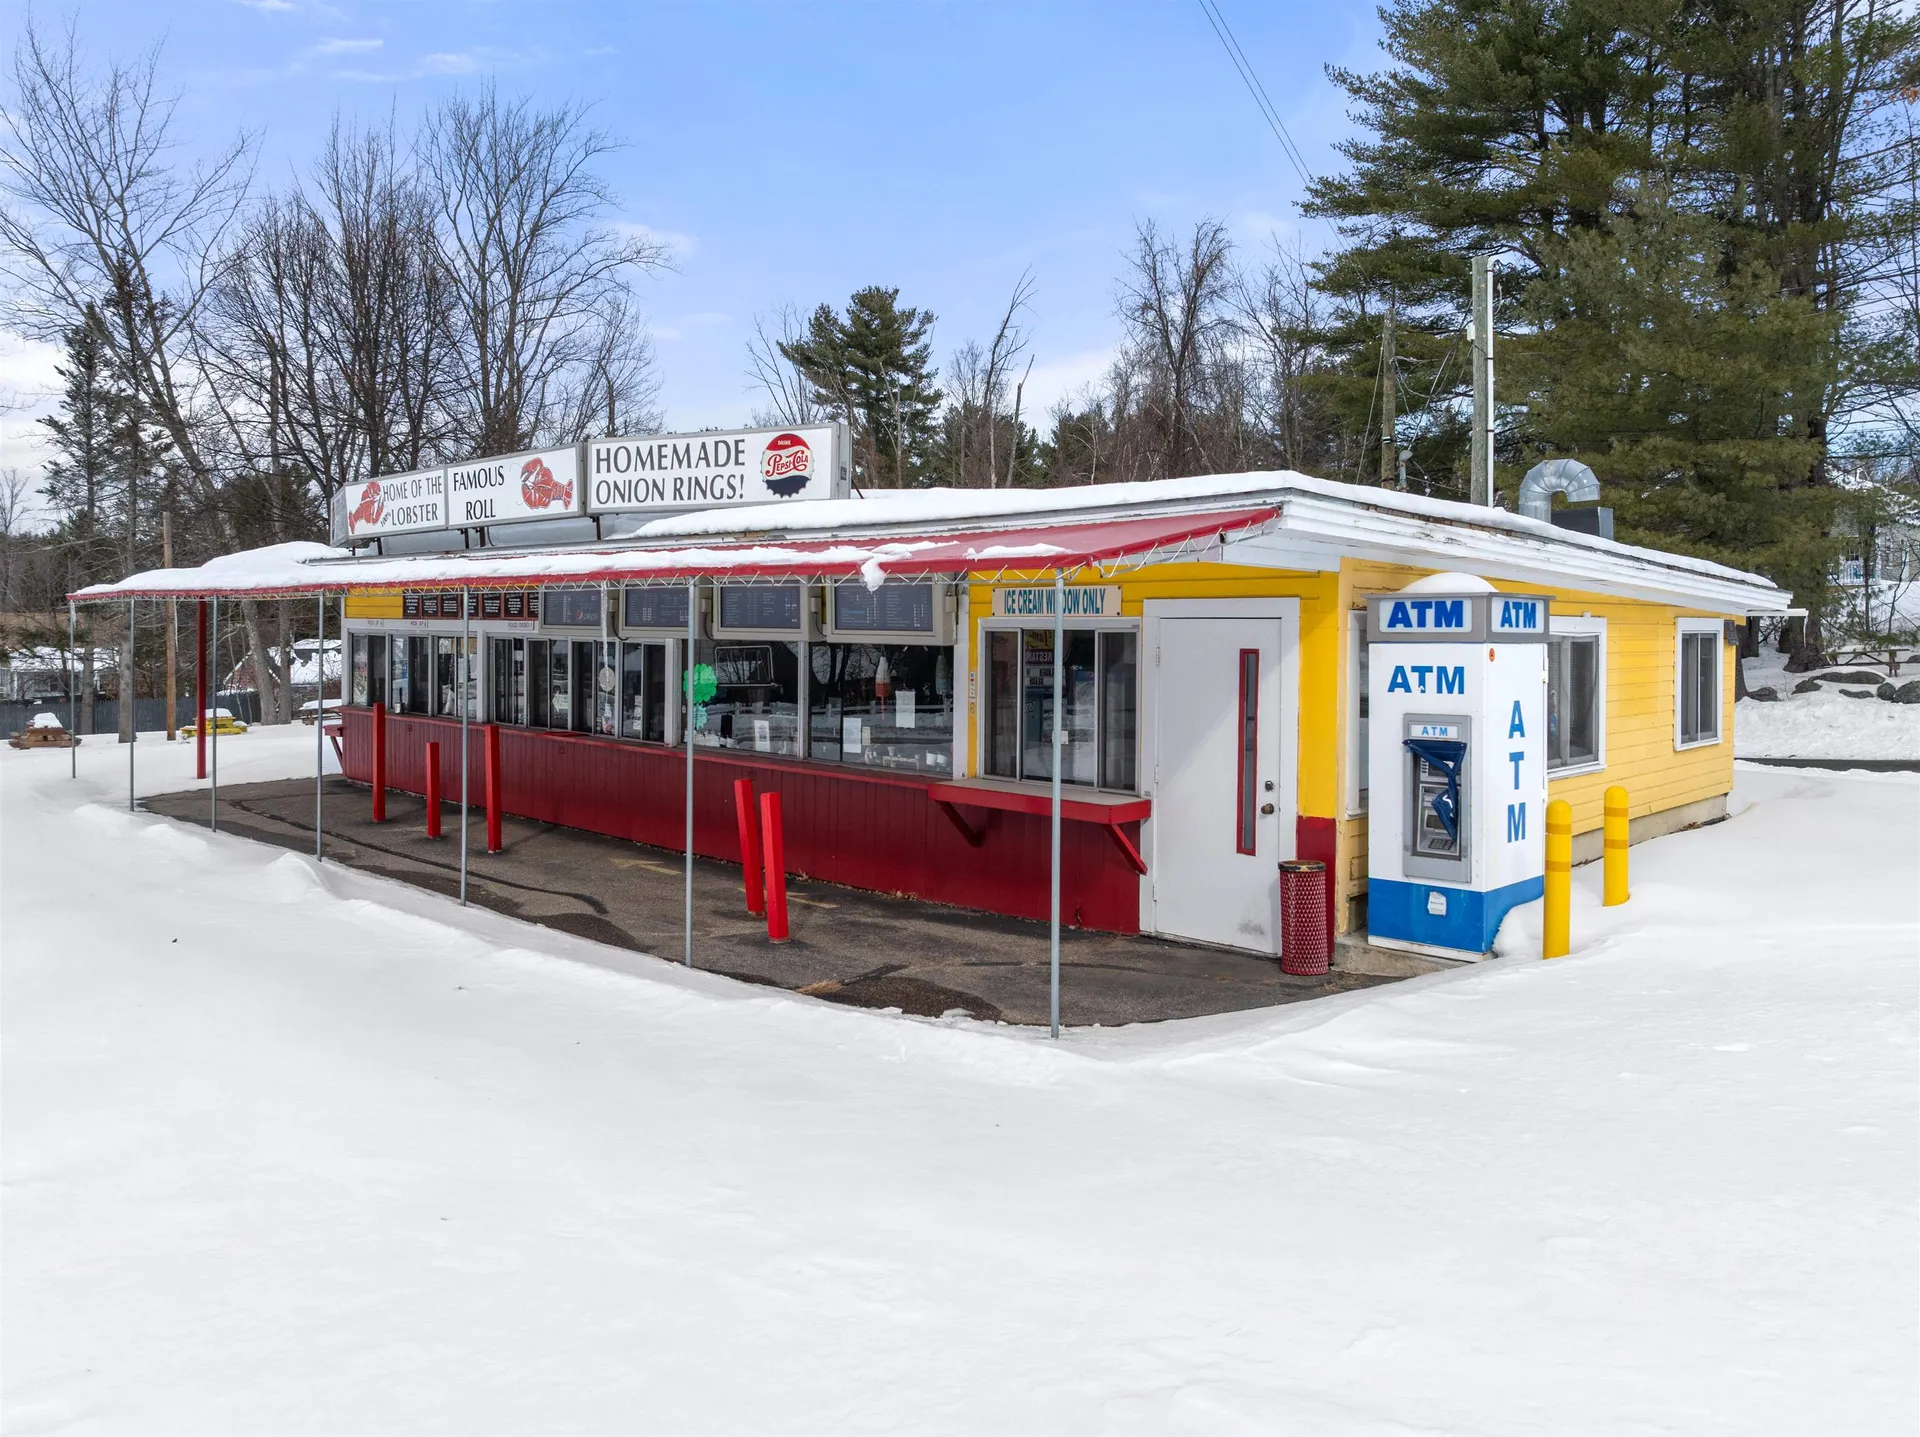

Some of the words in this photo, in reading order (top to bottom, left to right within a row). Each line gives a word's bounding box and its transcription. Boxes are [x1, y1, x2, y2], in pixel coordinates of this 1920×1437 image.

[596, 439, 745, 474] HOMEMADE
[382, 481, 408, 502] HOME
[411, 479, 423, 498] OF
[426, 476, 442, 496] THE
[453, 465, 505, 491] FAMOUS
[596, 478, 665, 505] ONION
[673, 474, 744, 501] RINGS!
[391, 502, 438, 526] LOBSTER
[466, 498, 496, 520] ROLL
[1004, 589, 1016, 614] ICE
[1018, 589, 1044, 614] CREAM
[1046, 588, 1080, 614] WIDOW
[1082, 588, 1106, 614] ONLY
[1387, 600, 1463, 628] ATM
[1501, 601, 1536, 628] ATM
[1387, 665, 1464, 694] ATM
[1421, 726, 1448, 737] ATM
[1508, 700, 1526, 843] ATM
